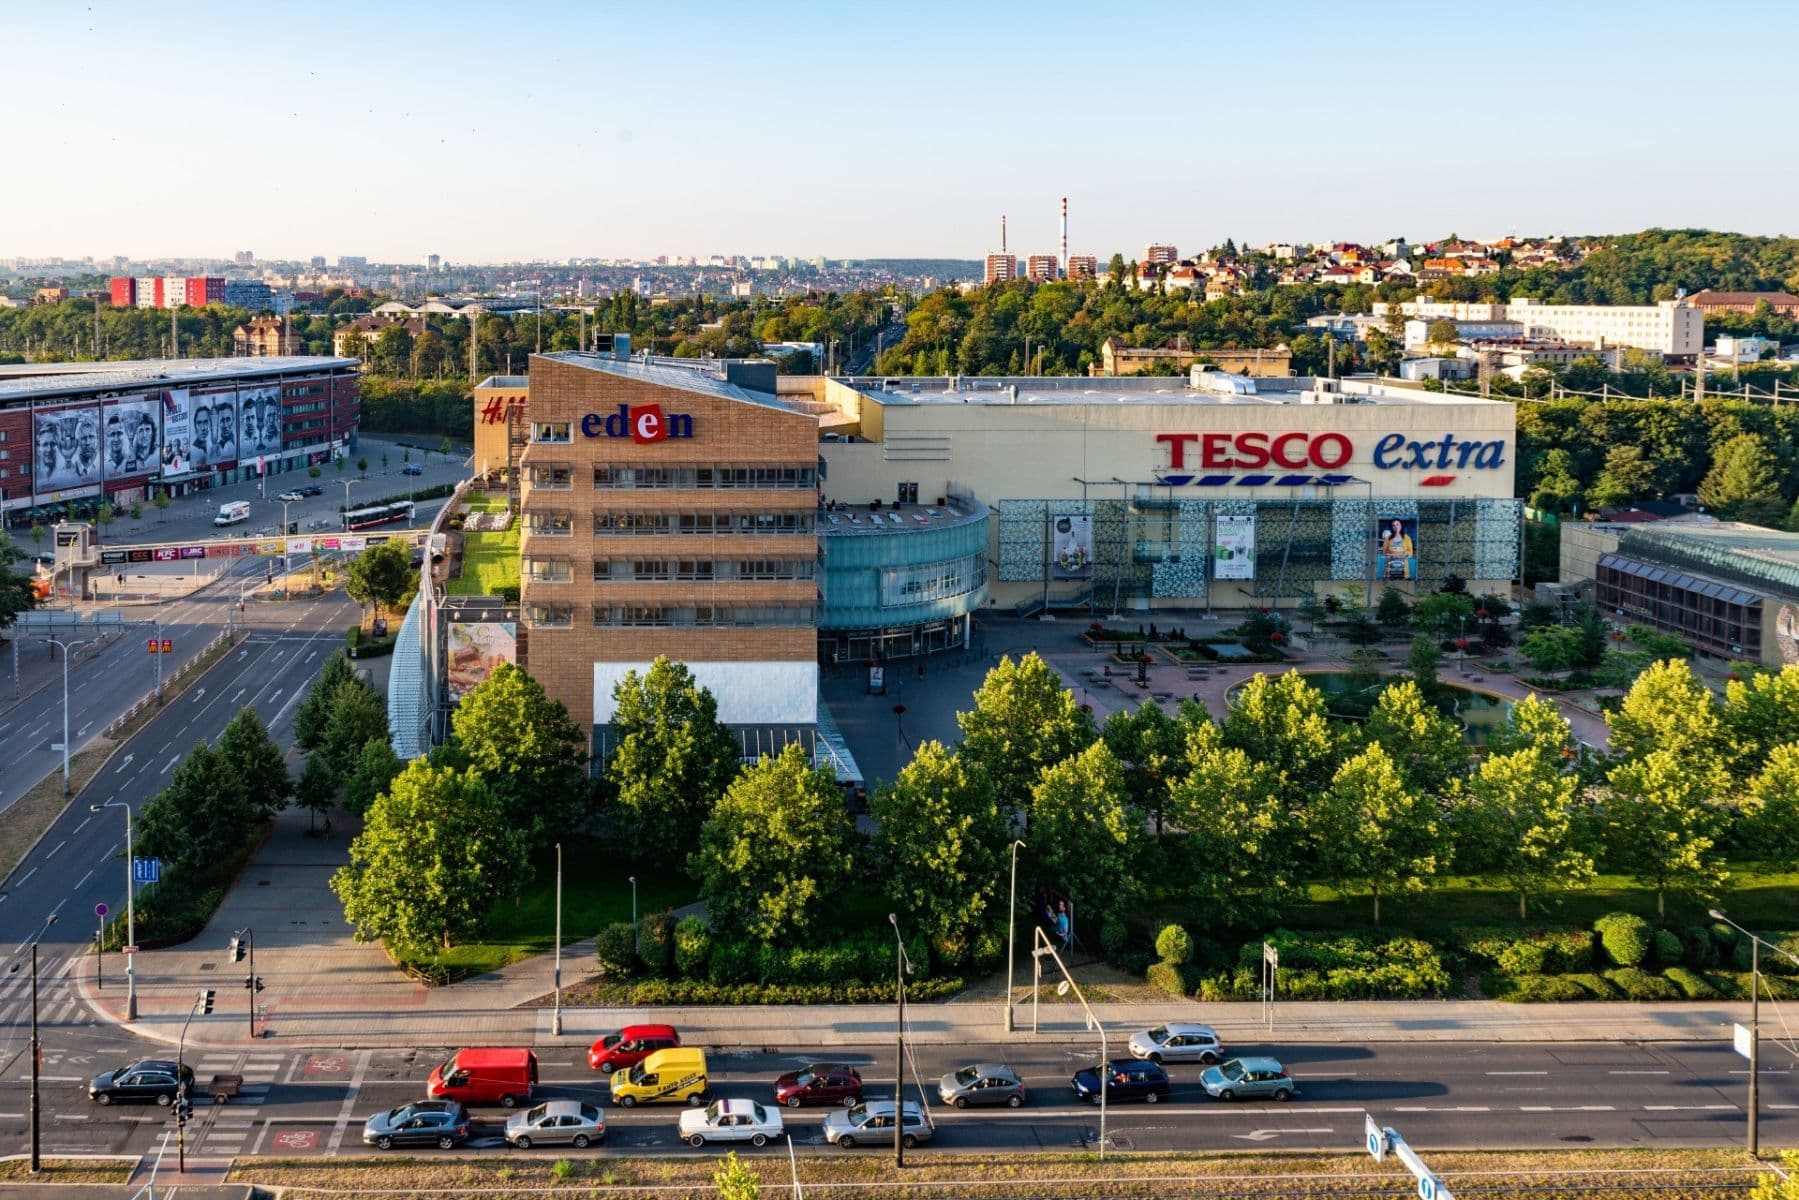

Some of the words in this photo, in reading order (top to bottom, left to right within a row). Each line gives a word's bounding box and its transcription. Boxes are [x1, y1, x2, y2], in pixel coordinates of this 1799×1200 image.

[481, 396, 526, 425] H&M
[581, 403, 694, 438] eden
[1156, 432, 1354, 469] TESCO
[1373, 432, 1505, 470] extra
